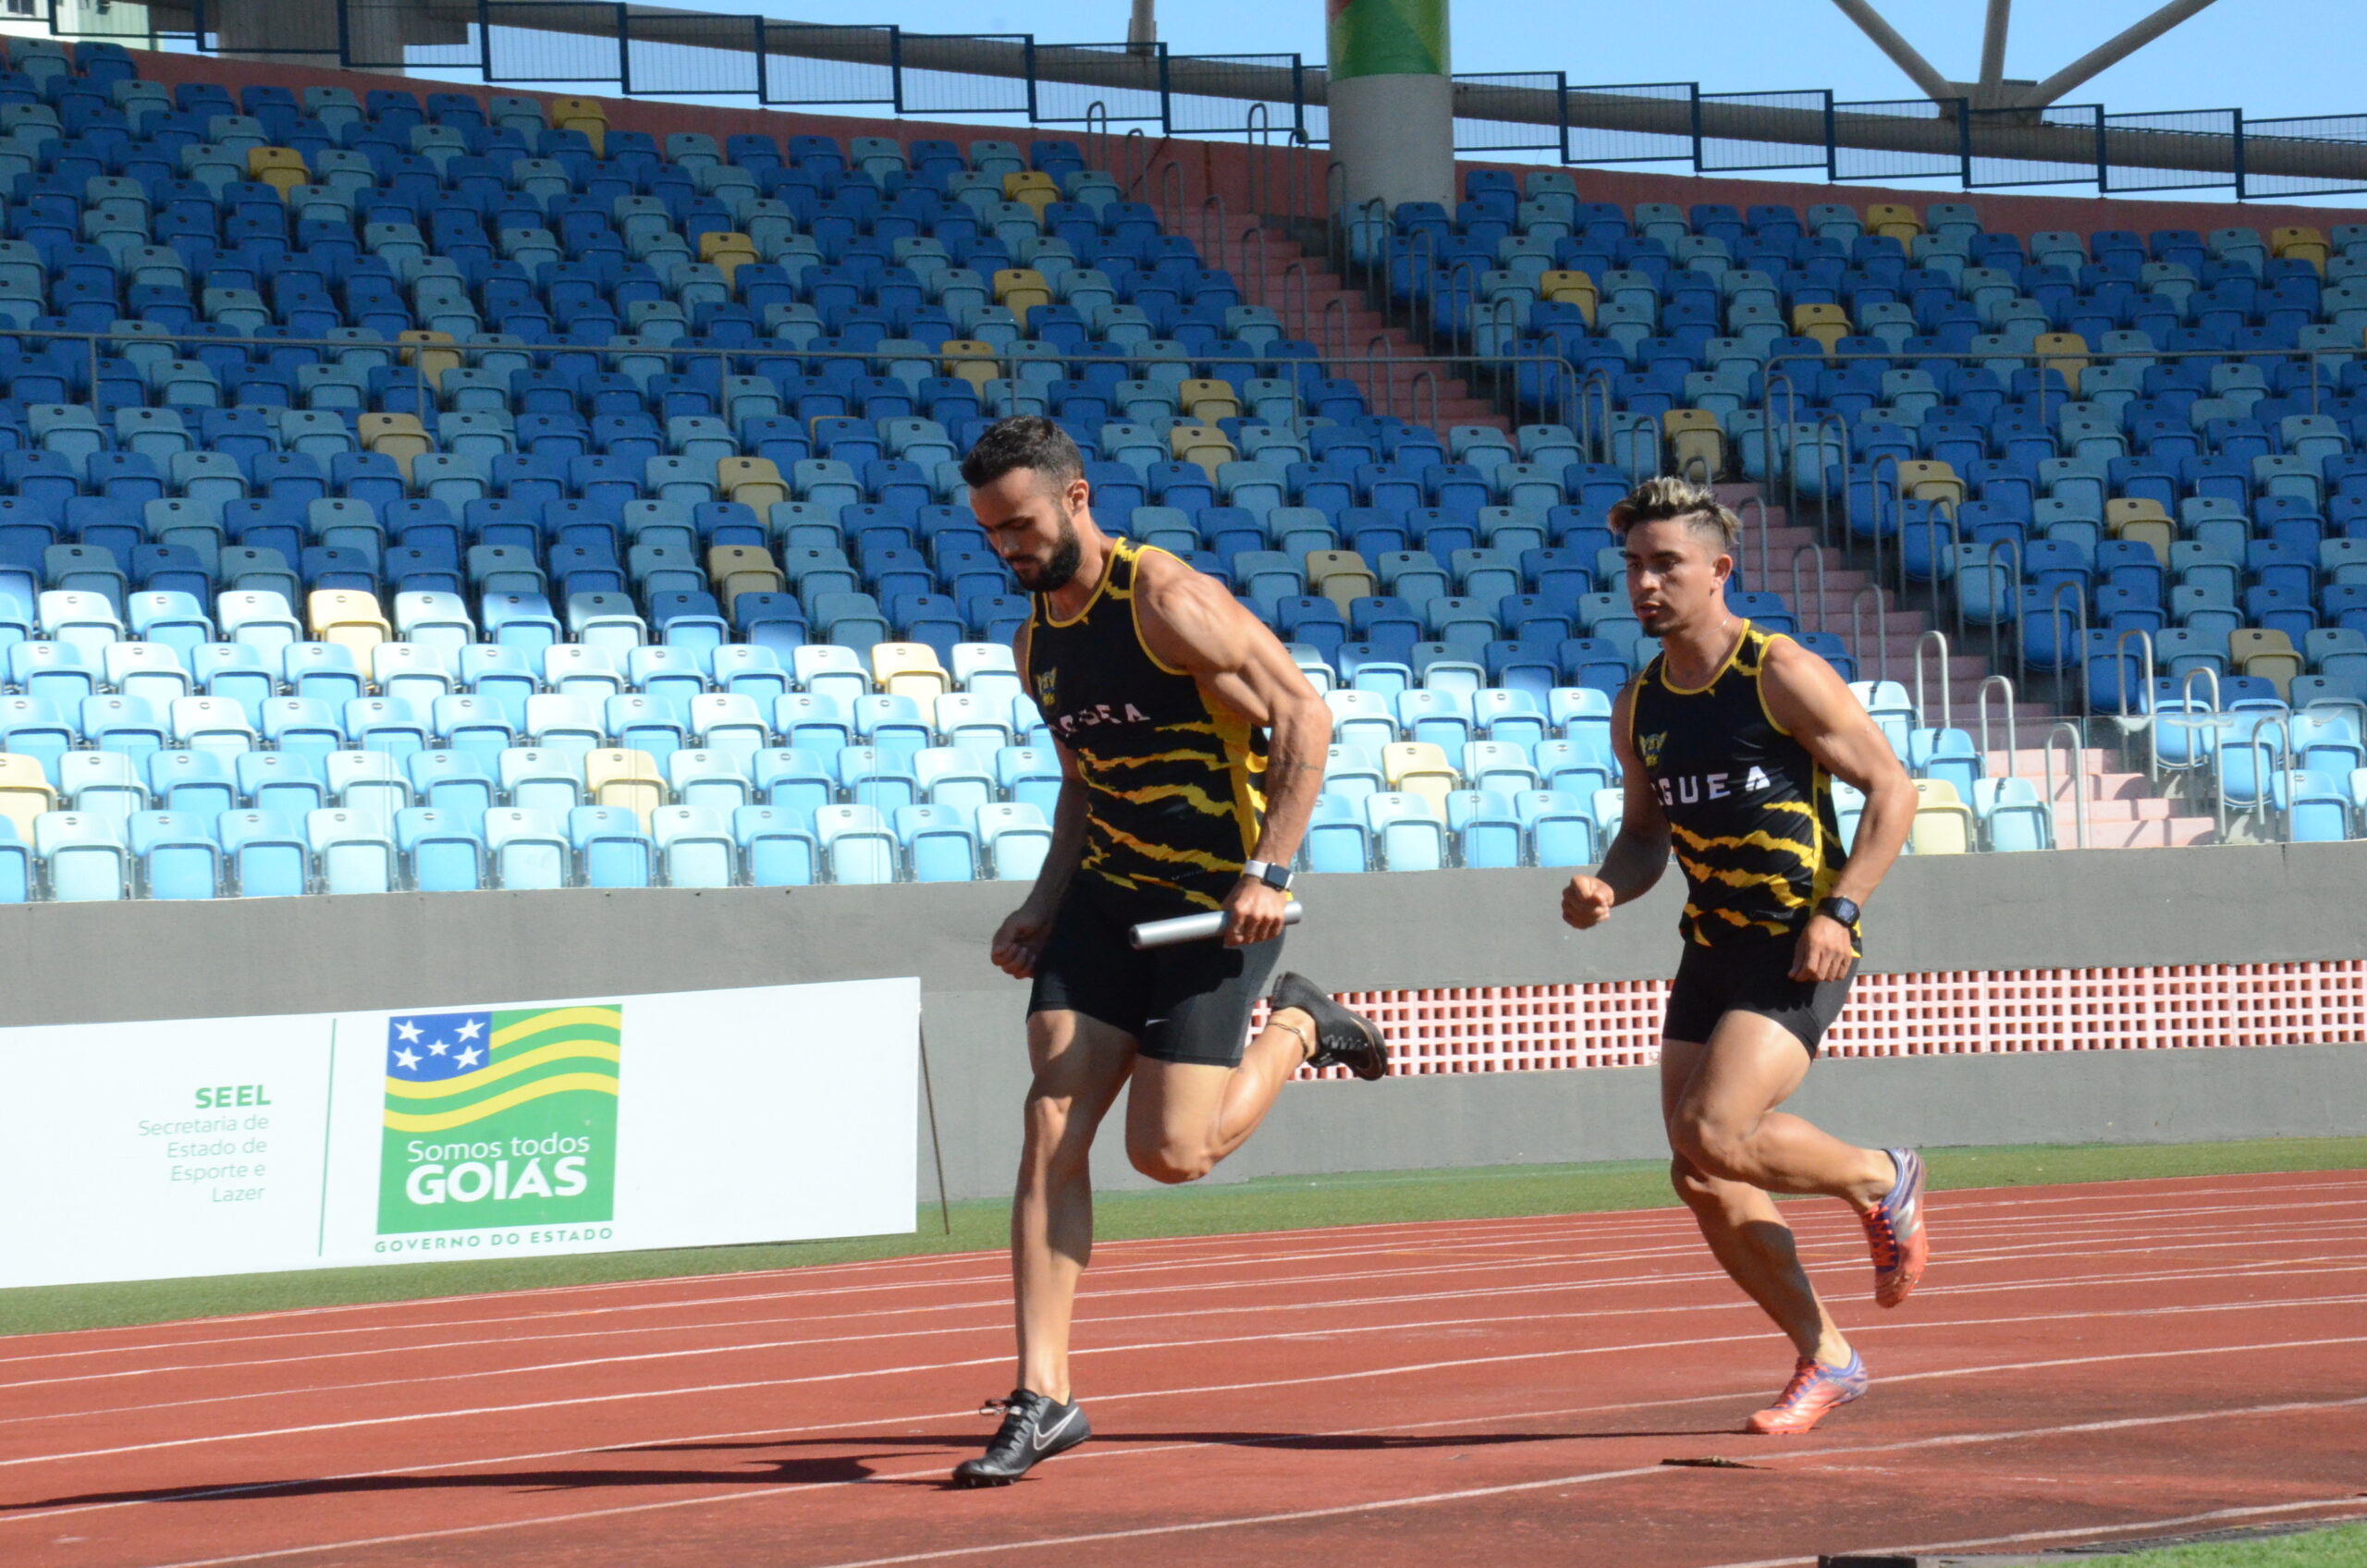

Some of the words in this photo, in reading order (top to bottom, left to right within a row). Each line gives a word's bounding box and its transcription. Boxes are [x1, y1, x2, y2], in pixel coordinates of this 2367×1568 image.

[195, 1084, 272, 1109] SEEL
[138, 1116, 238, 1136] Secretaria
[243, 1113, 269, 1131] de
[167, 1139, 236, 1158] Estado
[242, 1136, 267, 1154] de
[407, 1140, 502, 1162] Somos
[510, 1132, 590, 1157] todos
[171, 1164, 249, 1184] Esporte
[254, 1164, 266, 1176] e
[406, 1156, 588, 1206] GOIÁS
[212, 1186, 266, 1203] Lazer
[374, 1235, 481, 1253] GOVERNO
[491, 1232, 520, 1246] DO
[531, 1227, 613, 1243] ESTADO
